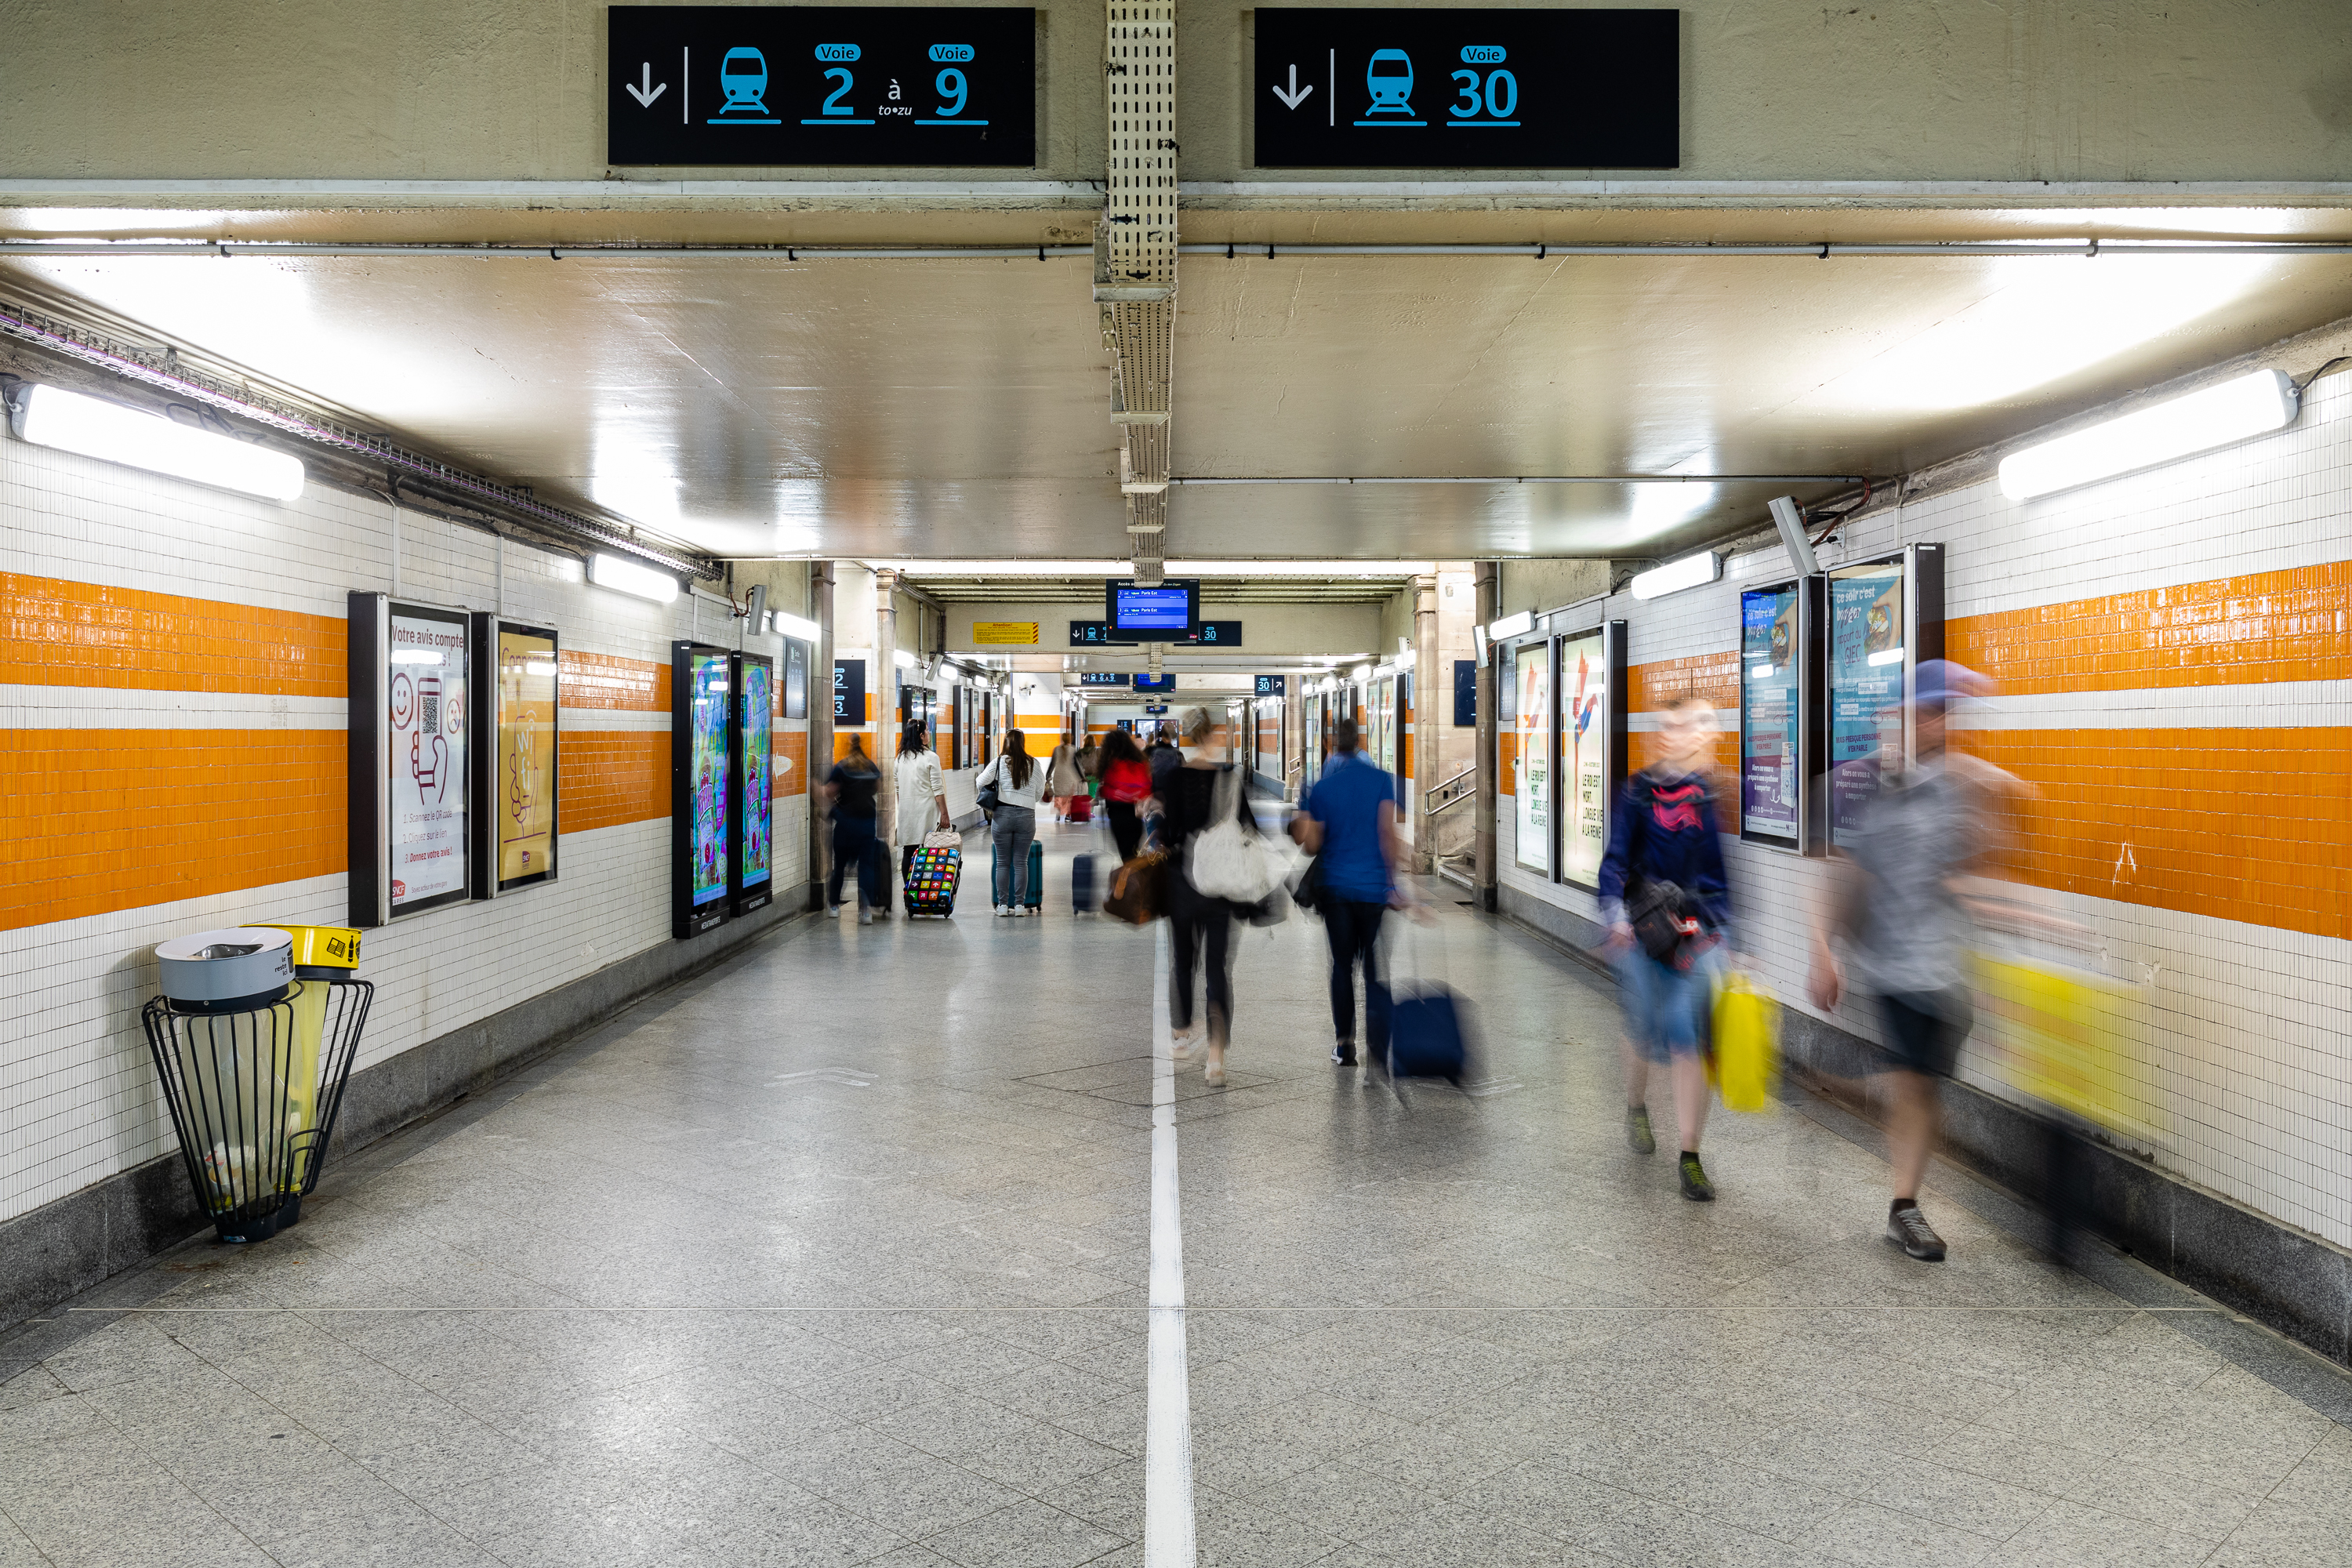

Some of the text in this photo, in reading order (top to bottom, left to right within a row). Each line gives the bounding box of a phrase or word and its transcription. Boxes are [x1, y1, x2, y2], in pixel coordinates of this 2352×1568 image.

[820, 46, 969, 60] Voie Voie
[1466, 47, 1501, 61] Voie
[822, 67, 967, 117] 2 à 9
[1449, 69, 1518, 118] 30
[1837, 585, 1875, 604] ce soir c'est
[392, 625, 463, 651] Votre avis compte
[1205, 631, 1216, 639] 30
[1837, 626, 1861, 649] rapport du
[1845, 644, 1861, 664] GIEC
[835, 674, 843, 686] 2
[1258, 681, 1270, 690] 30
[835, 701, 843, 713] 3
[517, 726, 533, 755] wi
[1845, 735, 1861, 743] PRESQUE
[1862, 733, 1881, 741] PERSONNE
[521, 757, 530, 790] fi
[1531, 770, 1535, 781] LE
[1583, 774, 1587, 786] LE
[1836, 779, 1851, 789] préparé
[1859, 782, 1877, 791] synthèse
[403, 809, 452, 824] 1. Scannez le QR code
[1583, 807, 1596, 821] LONGUE
[403, 834, 408, 844] 2.
[408, 832, 426, 844] Cliquez
[435, 829, 439, 839] le
[1585, 824, 1590, 837] LA
[1590, 825, 1601, 839] REINE
[405, 854, 409, 863] 3.
[410, 852, 426, 862] Donnez
[427, 850, 439, 859] votre
[440, 847, 450, 857] avis
[393, 885, 405, 896] SNCF
[275, 964, 287, 972] reste
